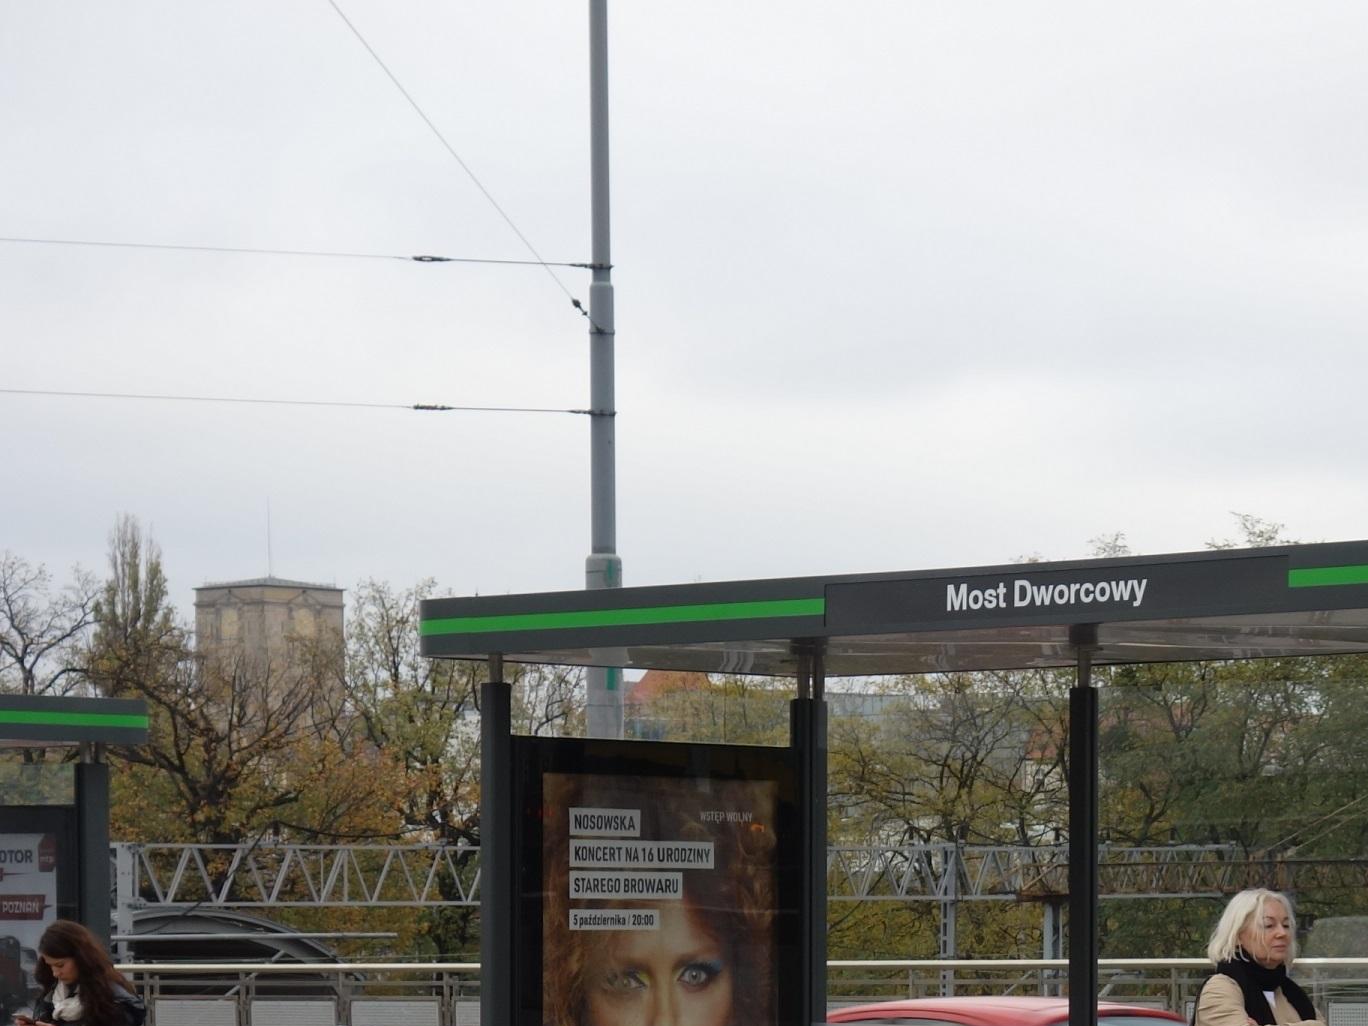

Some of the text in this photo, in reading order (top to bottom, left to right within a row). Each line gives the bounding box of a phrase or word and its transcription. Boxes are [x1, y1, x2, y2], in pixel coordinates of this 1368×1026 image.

[946, 578, 1148, 611] Most Dworcowy
[574, 814, 636, 831] NOSOWSKA
[700, 810, 753, 824] WSTĘP WOLNY
[574, 846, 711, 863] KONCERT NA 16 URODZINY
[573, 877, 679, 893] STAREGO BROWARU
[573, 914, 579, 926] 5
[579, 913, 626, 928] października
[632, 914, 654, 926] 20:00
